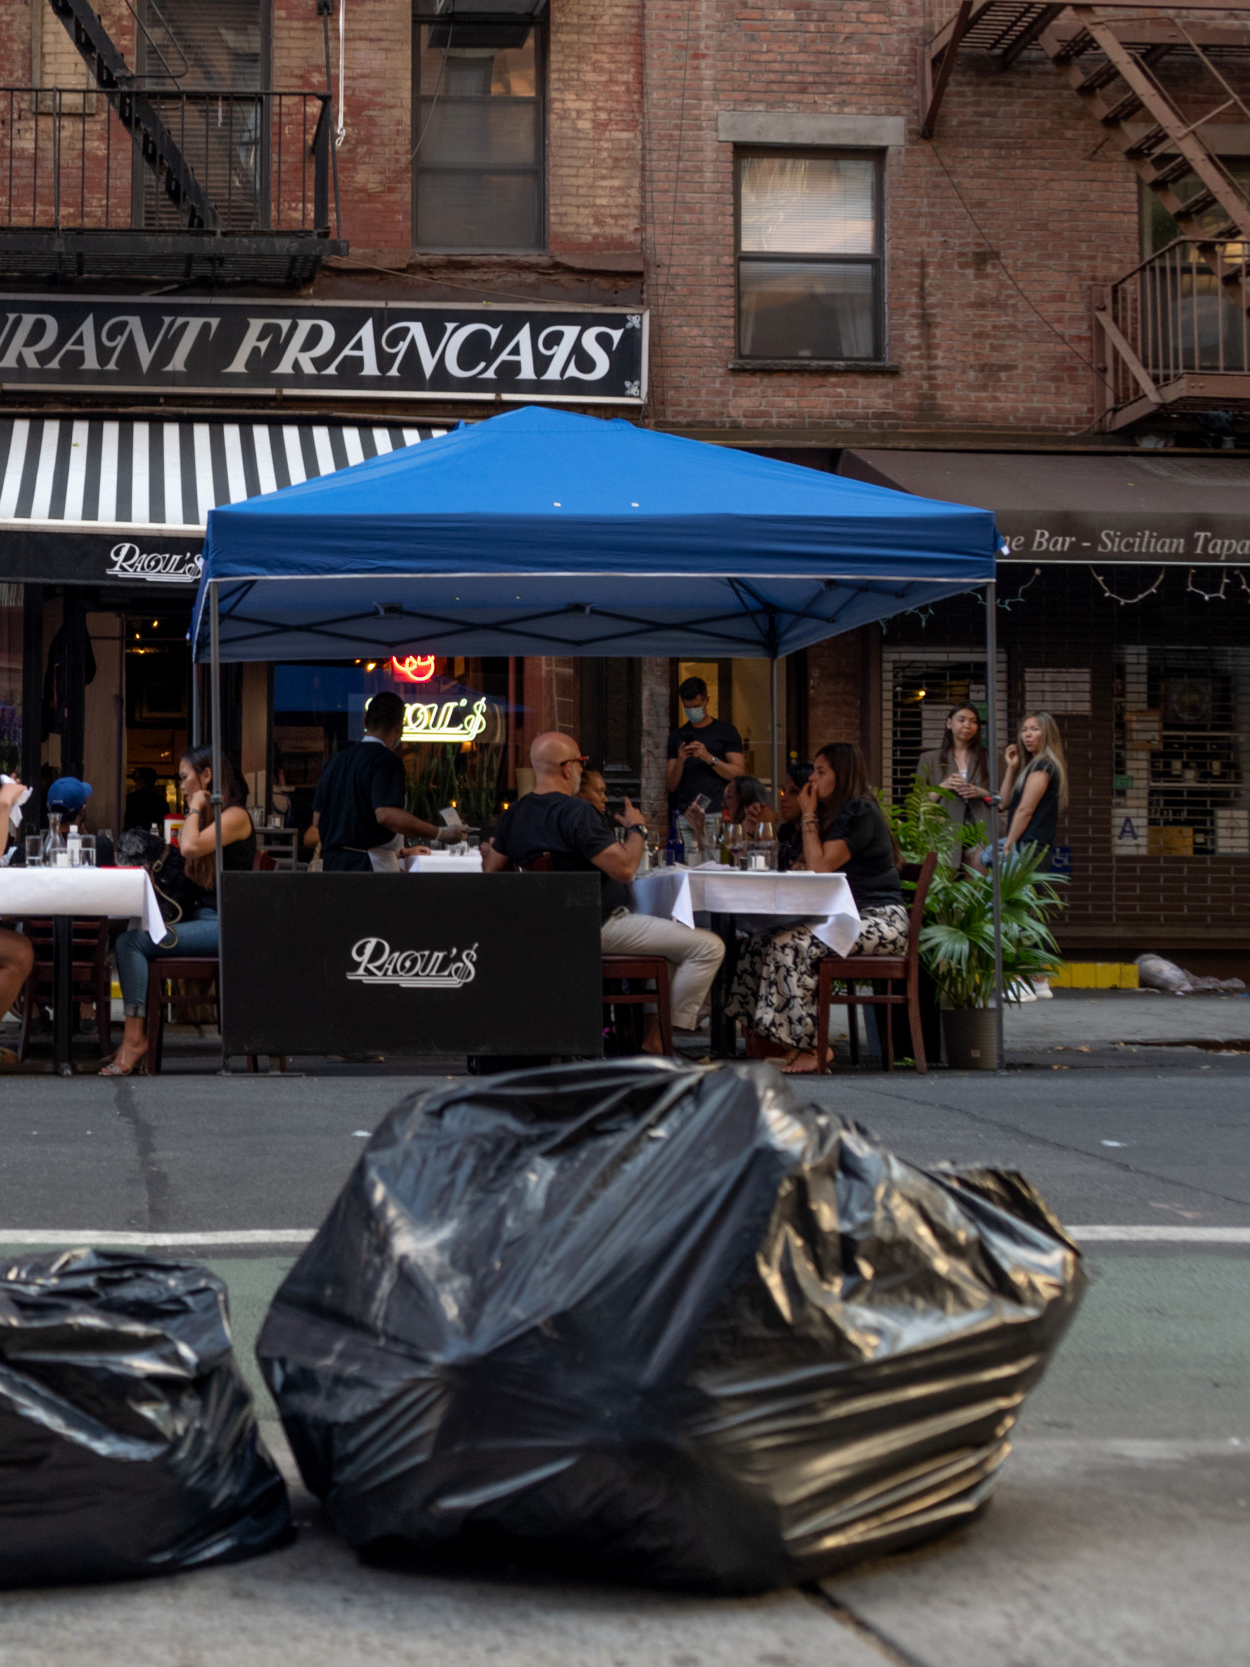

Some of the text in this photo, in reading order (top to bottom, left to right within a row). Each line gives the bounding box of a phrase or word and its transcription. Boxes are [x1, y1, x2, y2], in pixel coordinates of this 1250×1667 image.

[221, 317, 625, 381] FRANCAIS
[1031, 529, 1077, 552] Bar
[1097, 530, 1186, 554] Sicilian
[1118, 817, 1138, 840] A
